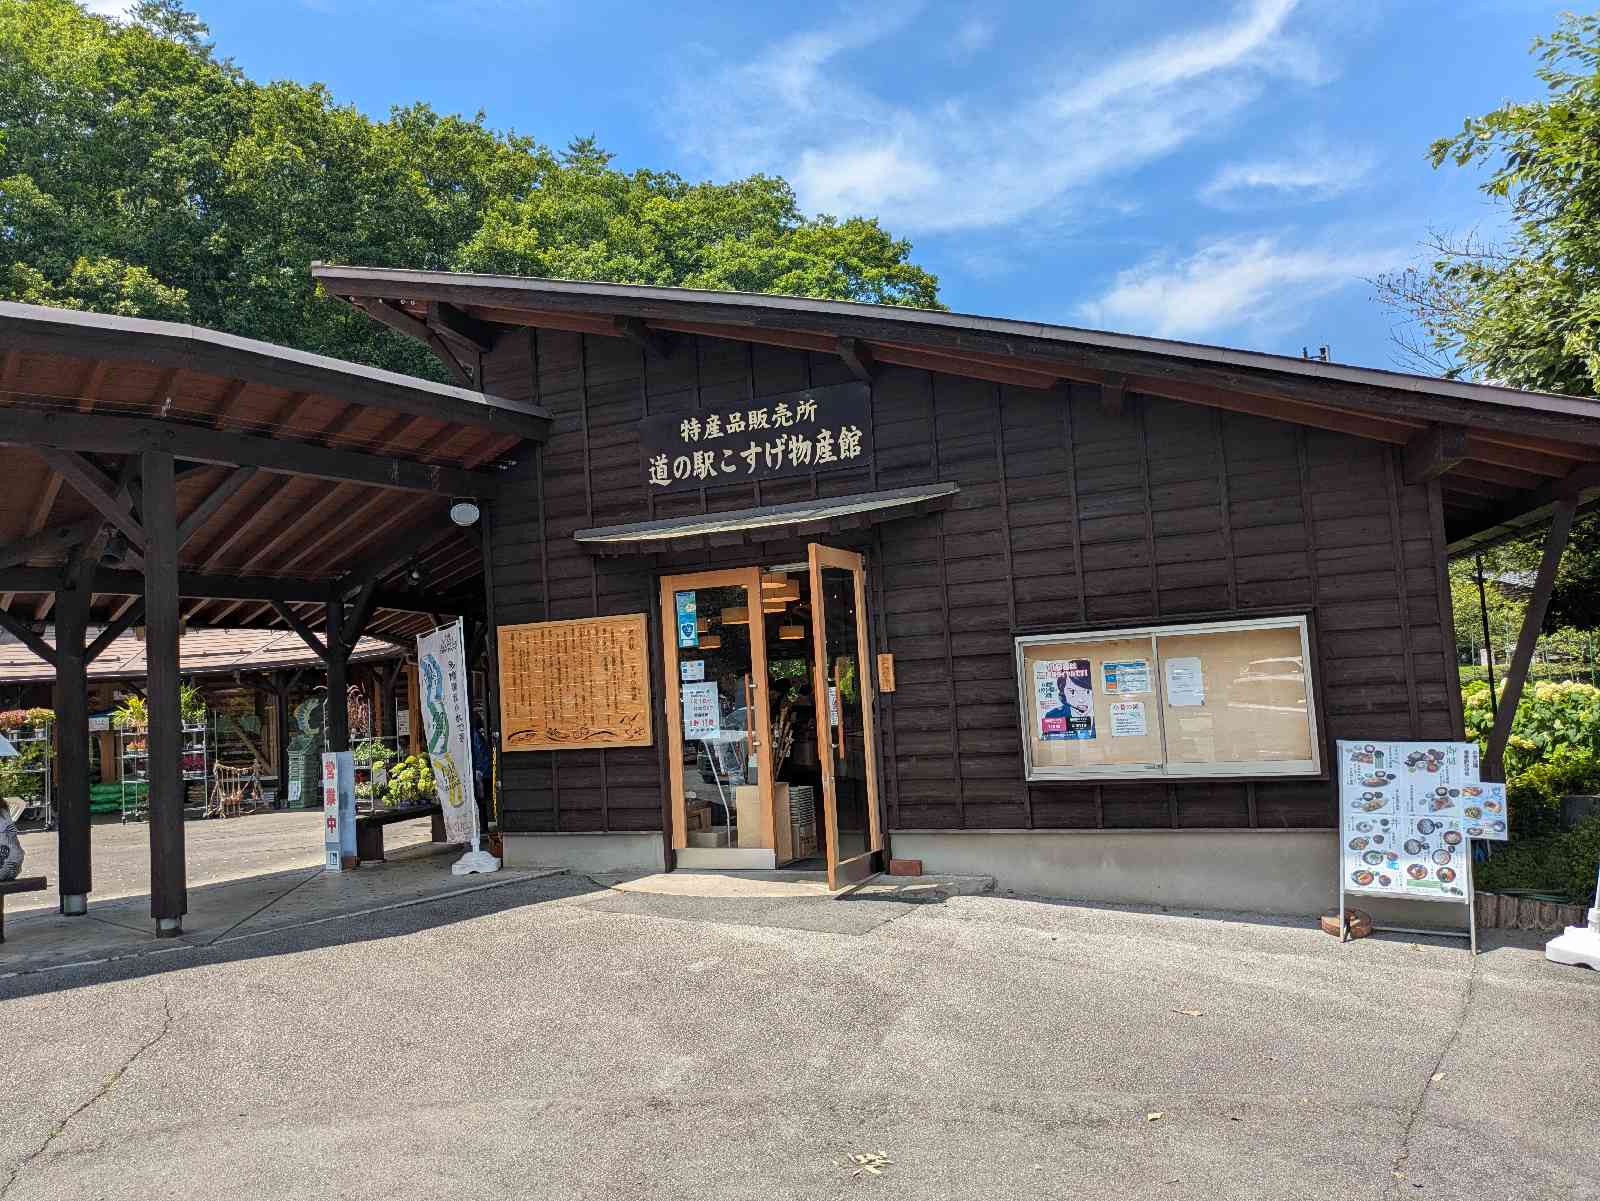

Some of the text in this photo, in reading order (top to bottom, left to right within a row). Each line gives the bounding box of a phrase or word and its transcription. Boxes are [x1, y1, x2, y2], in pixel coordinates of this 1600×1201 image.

[681, 400, 817, 442] 特産品販売所
[649, 425, 862, 486] 道の駅こすげ物産館
[325, 760, 336, 833] 営業中
